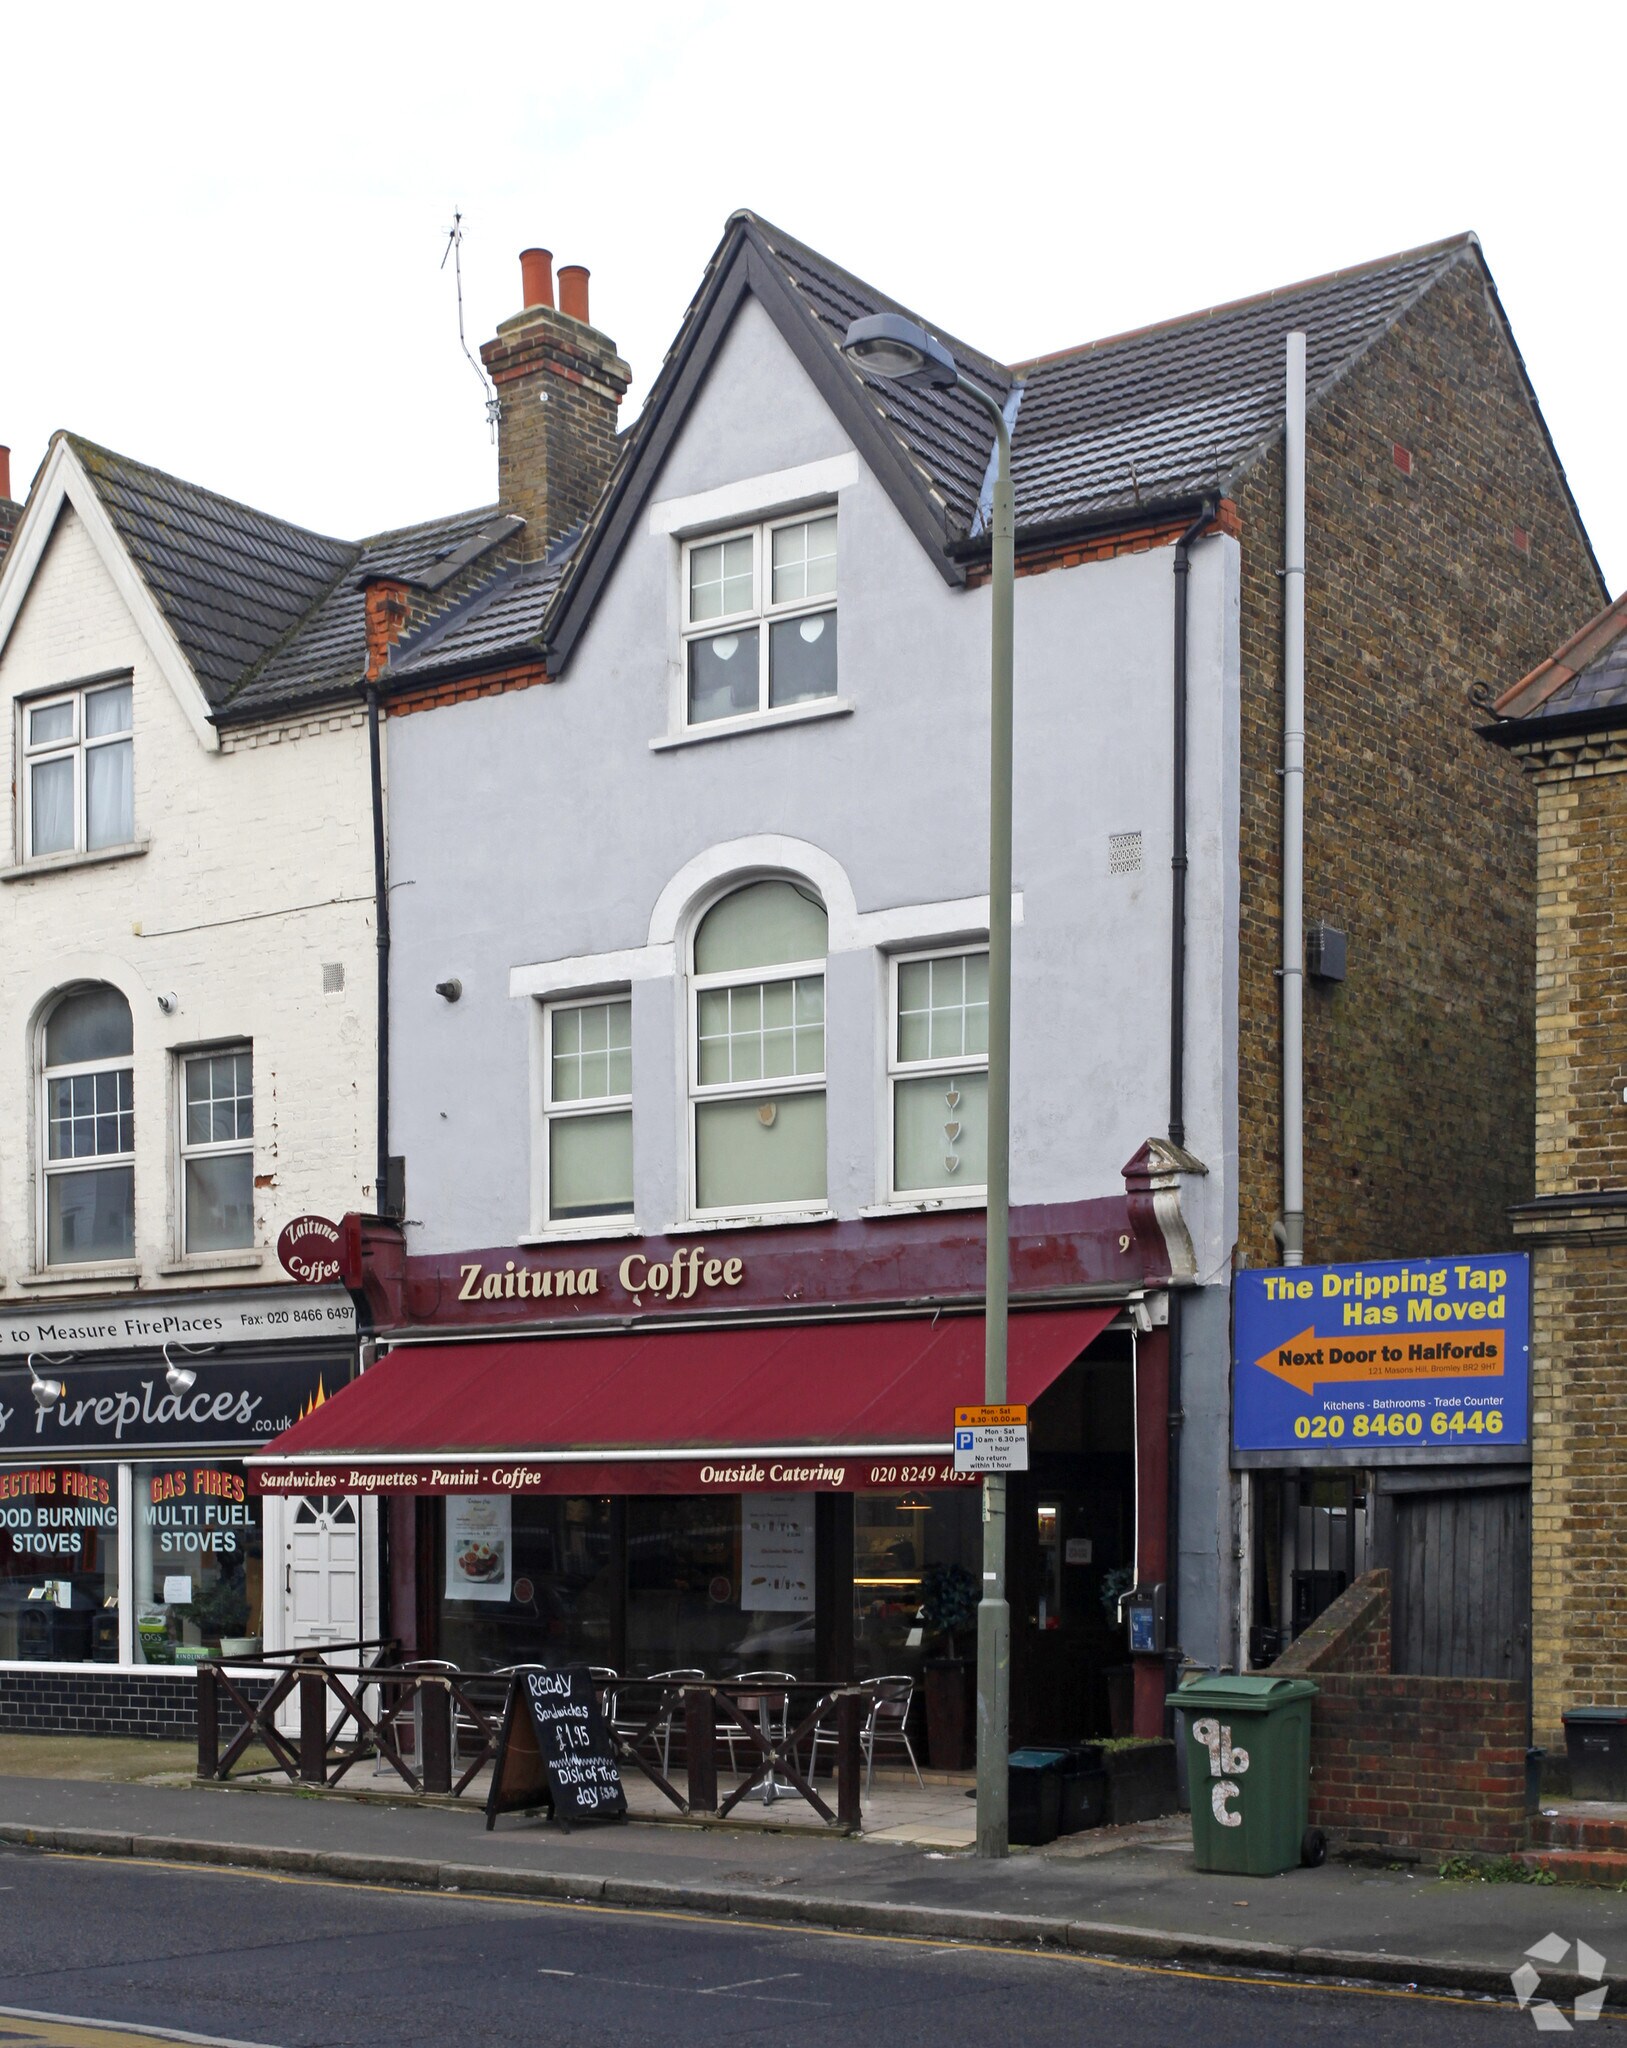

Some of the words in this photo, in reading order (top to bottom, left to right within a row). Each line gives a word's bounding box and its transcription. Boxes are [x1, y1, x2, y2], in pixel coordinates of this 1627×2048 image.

[285, 1217, 340, 1245] Zaituna
[1118, 1234, 1130, 1253] 9
[288, 1256, 340, 1283] Coffee
[458, 1260, 599, 1300] Zaituna
[618, 1247, 743, 1300] Coffee
[1263, 1277, 1314, 1300] The
[1322, 1268, 1447, 1300] Dripping
[1454, 1266, 1507, 1293] Tap
[240, 1314, 264, 1326] Fax:
[267, 1311, 289, 1325] 020
[293, 1309, 323, 1322] 8466
[326, 1307, 355, 1320] 6497
[1343, 1302, 1398, 1326] Has
[1407, 1294, 1505, 1323] Moved
[11, 1329, 30, 1342] to
[37, 1324, 117, 1341] Measure
[124, 1316, 223, 1336] FirePlaces
[1279, 1349, 1324, 1366] Next
[1329, 1348, 1377, 1364] Door
[1381, 1346, 1403, 1361] to
[1408, 1341, 1498, 1360] Halfords
[1369, 1367, 1382, 1375] 121
[1431, 1364, 1460, 1373] Bromley
[1463, 1363, 1479, 1371] BR2
[1323, 1400, 1365, 1411] Kitchens
[1373, 1399, 1426, 1409] Bathrooms
[1434, 1397, 1461, 1407] Trade
[1464, 1396, 1504, 1406] Counter
[252, 1416, 292, 1432] .co.uk
[1294, 1415, 1345, 1438] 020
[1352, 1412, 1423, 1437] 8460
[1430, 1410, 1503, 1435] 6446
[960, 1433, 971, 1449] P
[150, 1470, 187, 1503] GAS
[193, 1468, 245, 1502] FIRES
[259, 1470, 337, 1488] Sandwiches
[348, 1471, 418, 1491] Baguettes
[430, 1468, 479, 1487] Panini
[491, 1467, 541, 1488] Coffee
[700, 1464, 765, 1483] Outside
[769, 1463, 845, 1486] Catering
[870, 1466, 896, 1482] 020
[901, 1466, 936, 1482] 8249
[62, 1469, 109, 1504] FIRES
[37, 1506, 118, 1527] BURNING
[144, 1505, 198, 1525] MULTI
[205, 1505, 256, 1525] FUEL
[12, 1532, 81, 1553] STOVES
[161, 1532, 236, 1552] STOVES
[140, 1633, 161, 1641] LOGS
[534, 1702, 589, 1722] Sandwiches
[556, 1723, 590, 1751] £1.95
[558, 1766, 585, 1784] Dish
[585, 1765, 597, 1782] of
[598, 1765, 620, 1782] The
[576, 1786, 599, 1808] day
